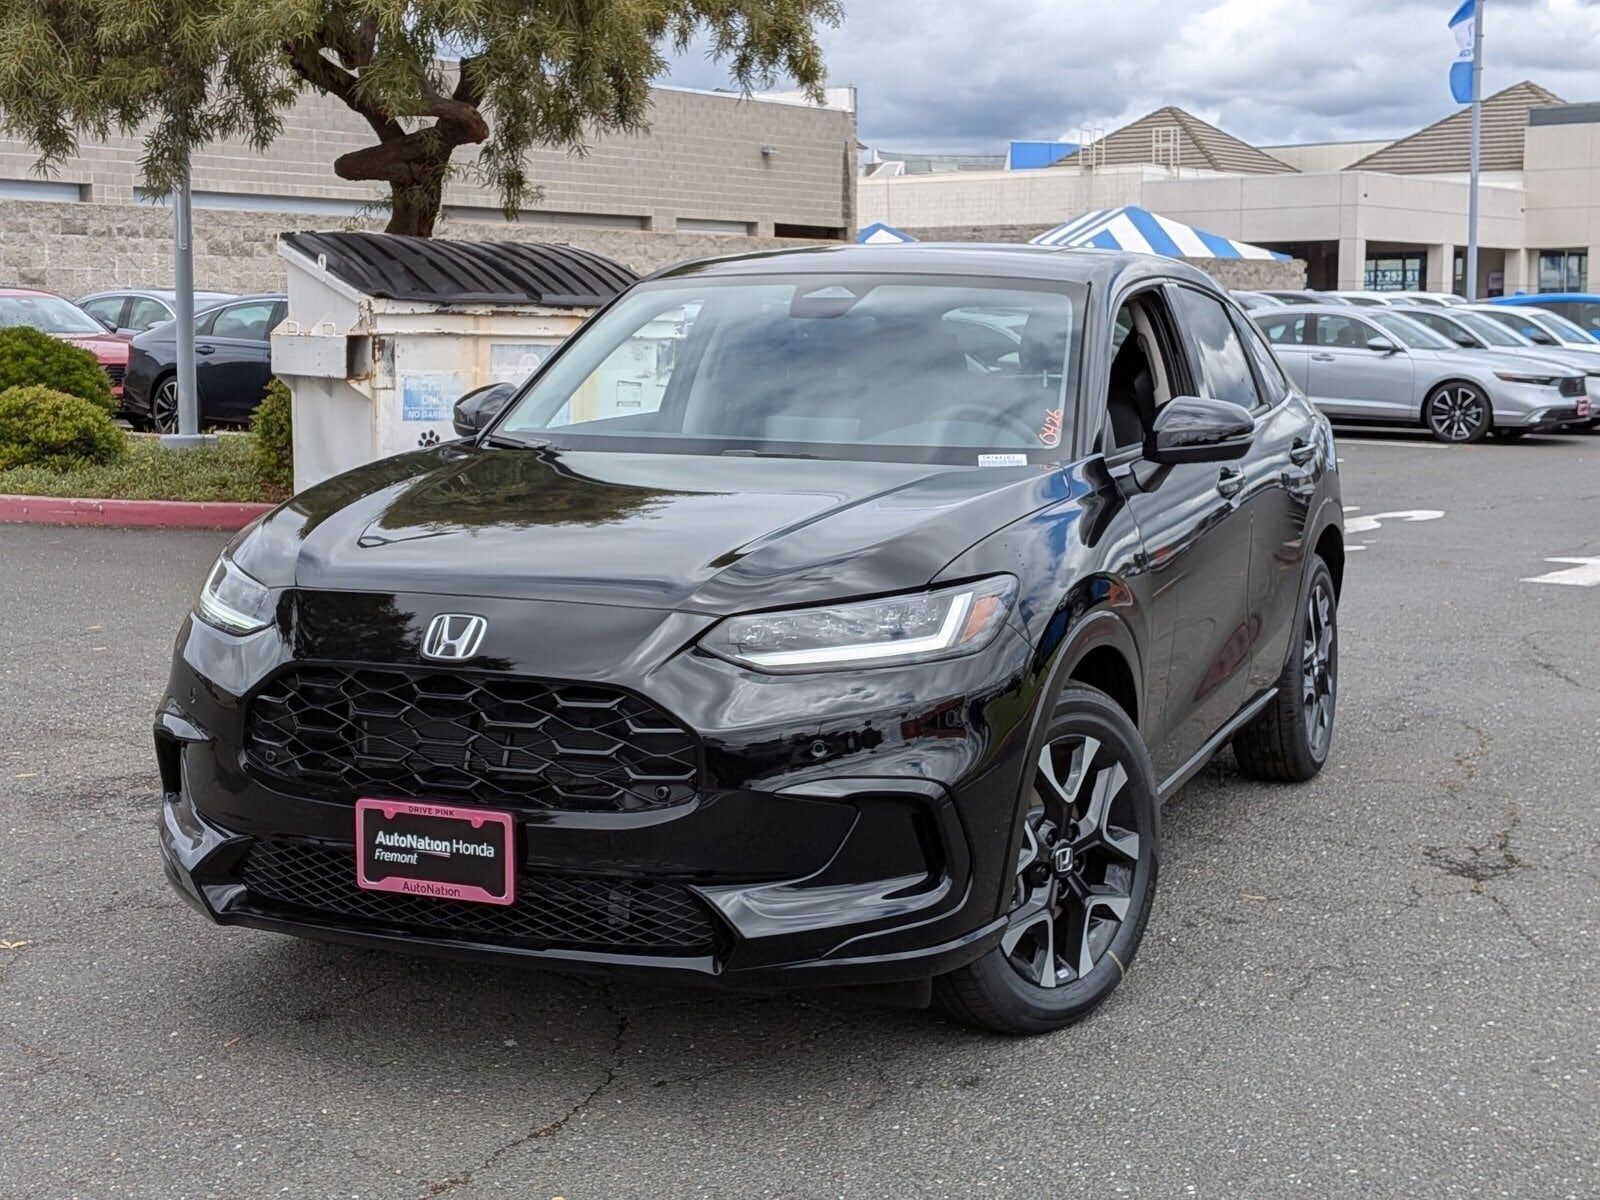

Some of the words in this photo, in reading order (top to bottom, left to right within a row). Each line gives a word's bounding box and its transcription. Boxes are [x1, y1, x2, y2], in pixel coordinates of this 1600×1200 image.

[408, 806, 433, 815] DRIVE
[435, 808, 456, 817] PINK
[374, 830, 450, 852] AutoNation
[452, 839, 495, 858] Honda
[374, 849, 418, 865] Fremont
[402, 881, 461, 897] AutoNation
